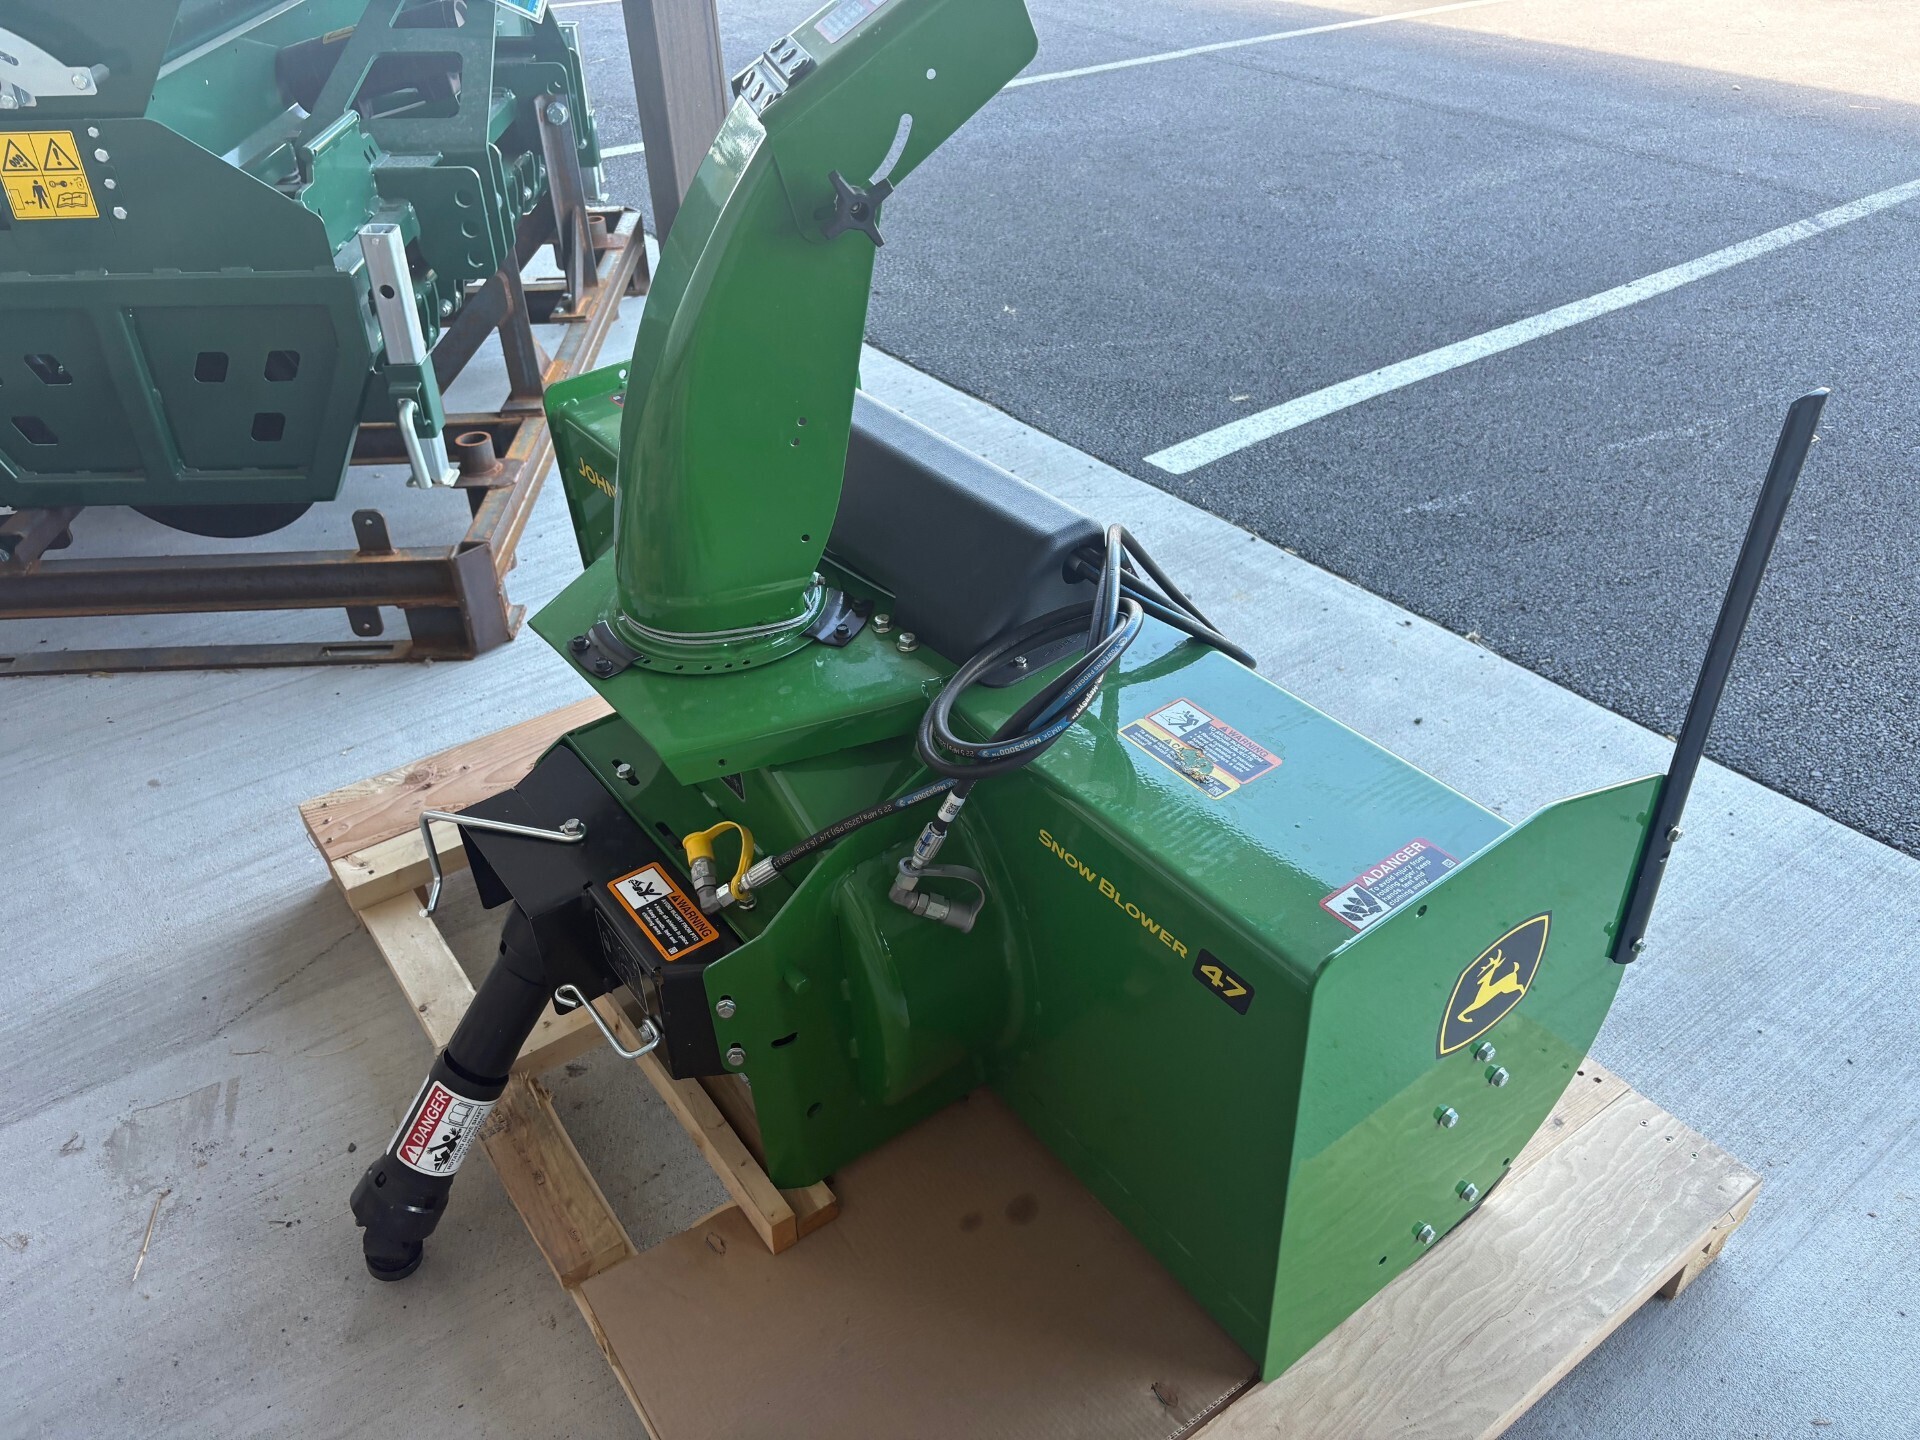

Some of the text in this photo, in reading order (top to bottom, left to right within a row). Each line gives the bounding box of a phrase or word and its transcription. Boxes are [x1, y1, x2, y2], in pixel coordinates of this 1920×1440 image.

[579, 457, 617, 498] JOHN
[1092, 645, 1120, 671] POWERING
[1196, 735, 1209, 744] Keep
[1201, 732, 1213, 741] Read
[1209, 732, 1253, 761] THROWN OBJECTS
[1215, 731, 1230, 741] AVOID
[1229, 741, 1248, 752] INJURY
[1247, 752, 1263, 762] FROM
[1228, 731, 1270, 757] WARNING
[1369, 840, 1425, 880] DANGER
[1370, 855, 1424, 893] To avoid injury from
[1038, 828, 1188, 959] SNOW BLOWER
[1376, 859, 1432, 898] rotating auger, keep
[1382, 871, 1424, 902] hands, feet and
[647, 909, 656, 918] Keep
[1388, 888, 1413, 907] clothing
[654, 906, 664, 914] Keep
[666, 919, 678, 930] shields
[678, 935, 689, 944] place
[661, 899, 672, 909] AVOID
[670, 910, 683, 921] INJURY
[681, 922, 692, 932] FROM
[678, 898, 712, 938] WARNING
[1200, 964, 1247, 997] 47
[412, 1090, 451, 1146] DANGER
[446, 1143, 464, 1169] ROTATING
[461, 1126, 473, 1142] DRIVE
[470, 1107, 483, 1124] SHAFT
